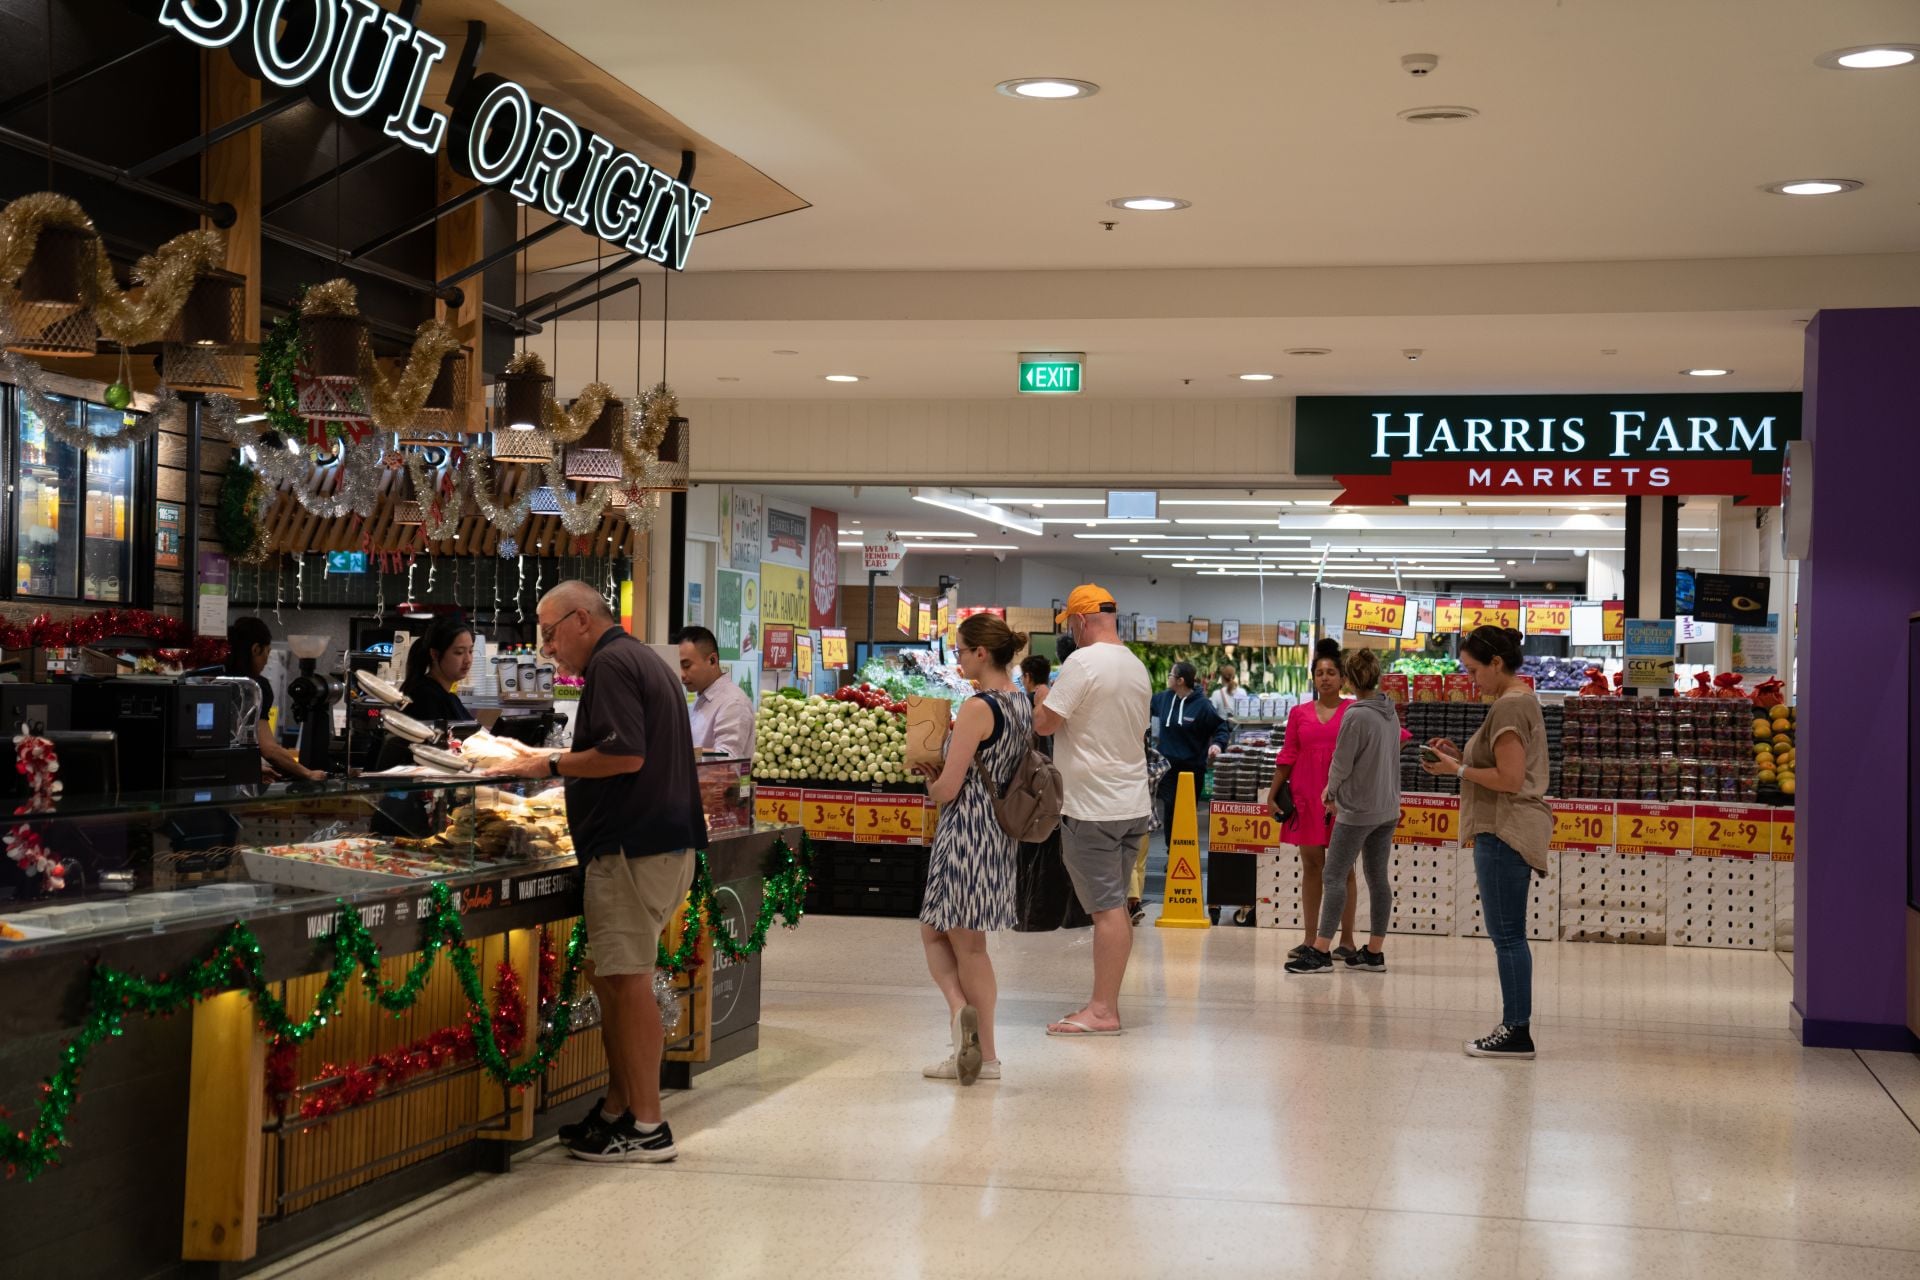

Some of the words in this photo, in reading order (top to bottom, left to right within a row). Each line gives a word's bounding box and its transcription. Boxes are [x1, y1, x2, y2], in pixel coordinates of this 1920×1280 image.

[468, 81, 712, 271] ORIGIN
[1036, 366, 1074, 388] EXIT
[1370, 412, 1585, 458] HARRIS
[1609, 410, 1777, 457] FARM
[1468, 467, 1671, 487] MARKETS
[864, 545, 888, 553] WEAR
[1353, 603, 1363, 619] 5
[1375, 606, 1396, 623] $10
[1473, 611, 1482, 627] 2
[1495, 611, 1509, 628] $6
[1527, 610, 1535, 623] 2
[1546, 611, 1565, 625] $10
[1631, 636, 1643, 644] OF
[1628, 660, 1656, 670] CCTV
[758, 808, 769, 816] for
[771, 802, 788, 823] $6
[1213, 803, 1261, 815] BLACKBERRIES
[1423, 798, 1445, 807] PREMIUM
[1575, 803, 1598, 812] PREMIUM
[814, 805, 824, 824] 3
[827, 811, 837, 820] for
[840, 806, 854, 826] $6
[867, 808, 878, 828] 3
[881, 815, 891, 824] for
[893, 808, 911, 830] $6
[1396, 809, 1406, 828] 2
[1408, 816, 1418, 824] for
[1421, 811, 1449, 833] $10
[1217, 816, 1228, 836] 3
[1231, 824, 1242, 832] for
[1245, 818, 1271, 840] $10
[1560, 822, 1572, 830] for
[1575, 816, 1603, 838] $10
[1631, 818, 1643, 838] 2
[1645, 826, 1657, 834] for
[1660, 819, 1679, 840] $9
[1708, 821, 1721, 841] 2
[1723, 829, 1735, 837] for
[1738, 822, 1758, 845] $9
[1781, 825, 1793, 846] 4
[856, 834, 880, 842] SPECIAL
[1617, 845, 1645, 854] SPECIAL
[1694, 847, 1721, 857] SPECIAL
[519, 880, 537, 900] WANT
[537, 876, 551, 897] FREE
[307, 913, 334, 939] WANT
